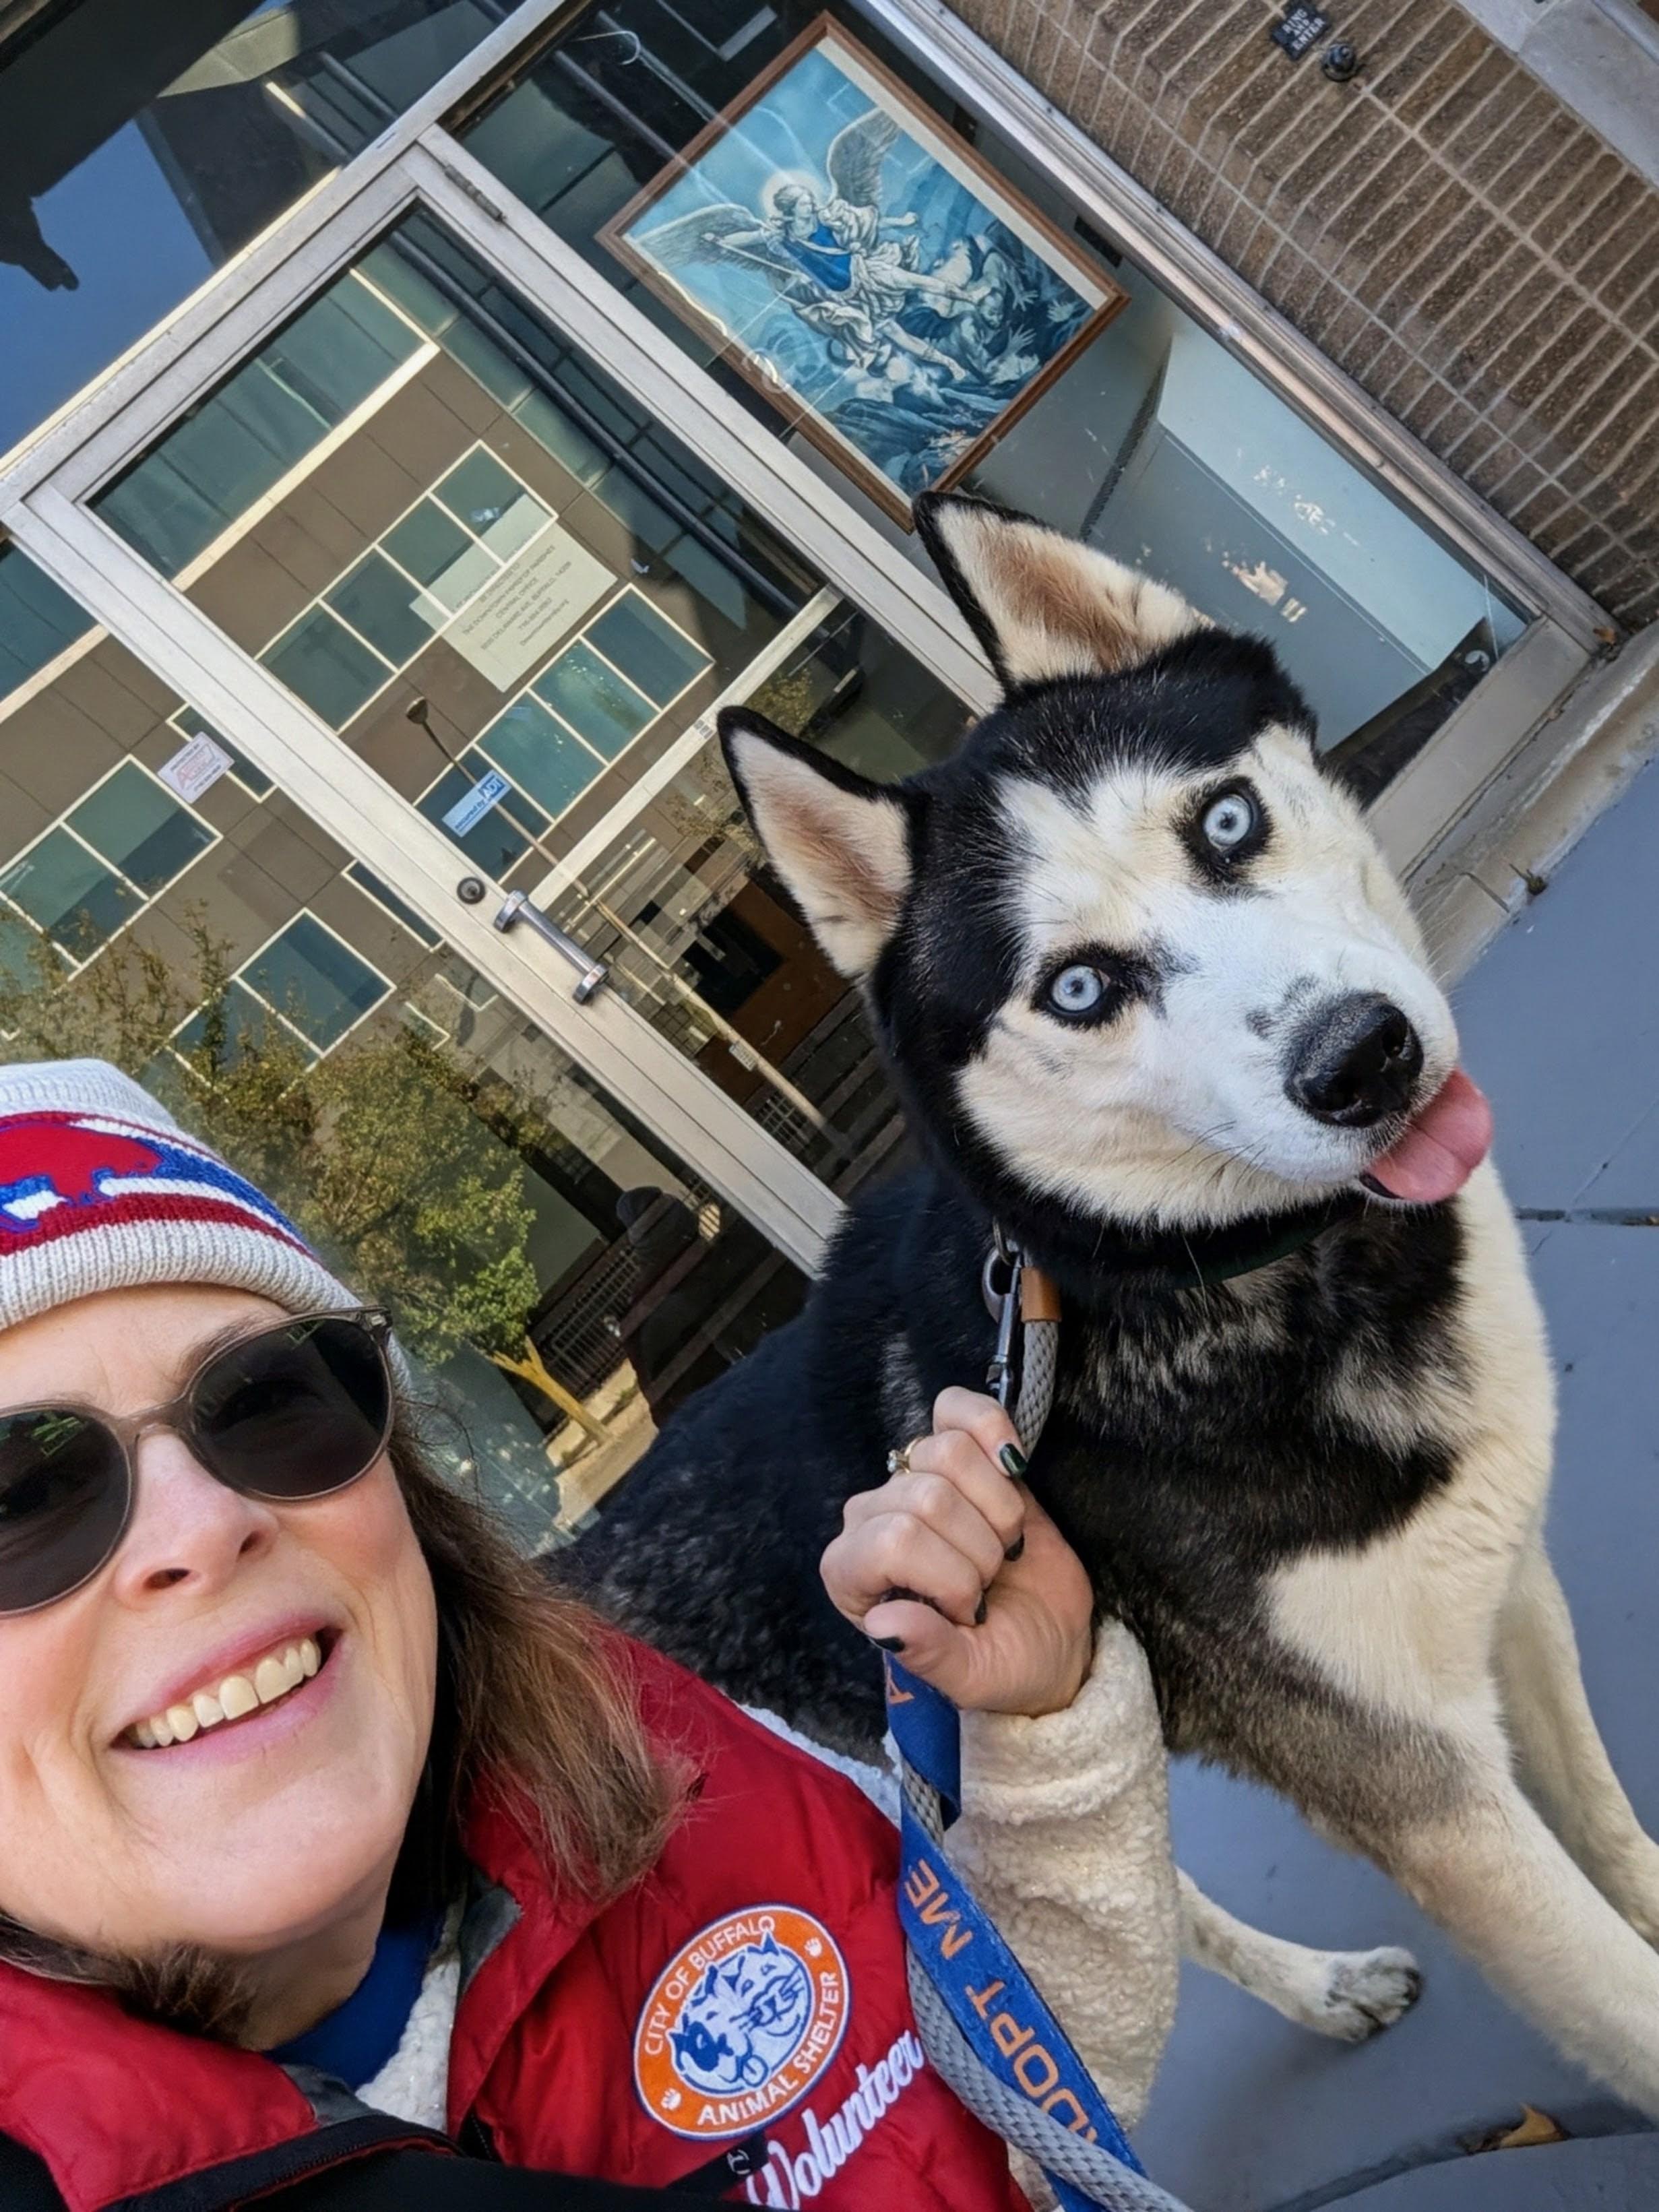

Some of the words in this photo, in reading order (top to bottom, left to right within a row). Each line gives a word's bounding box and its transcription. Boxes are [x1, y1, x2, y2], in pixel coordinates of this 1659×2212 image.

[1282, 9, 1307, 34] RING
[1292, 18, 1325, 50] ENTER
[1294, 19, 1310, 37] AND
[494, 592, 522, 619] CENTRAL
[519, 575, 539, 596] OFFICE
[492, 610, 522, 639] DELAWARE
[479, 776, 503, 800] ADT
[904, 1858, 974, 1961] ME
[645, 2002, 671, 2055] CITY
[666, 1966, 690, 1999] OF
[688, 1916, 775, 1969] BUFFALO
[697, 2074, 799, 2126] ANIMAL
[793, 1971, 839, 2074] SHELTER
[966, 1978, 1098, 2145] DOPT
[746, 2029, 923, 2210] Volunteer
